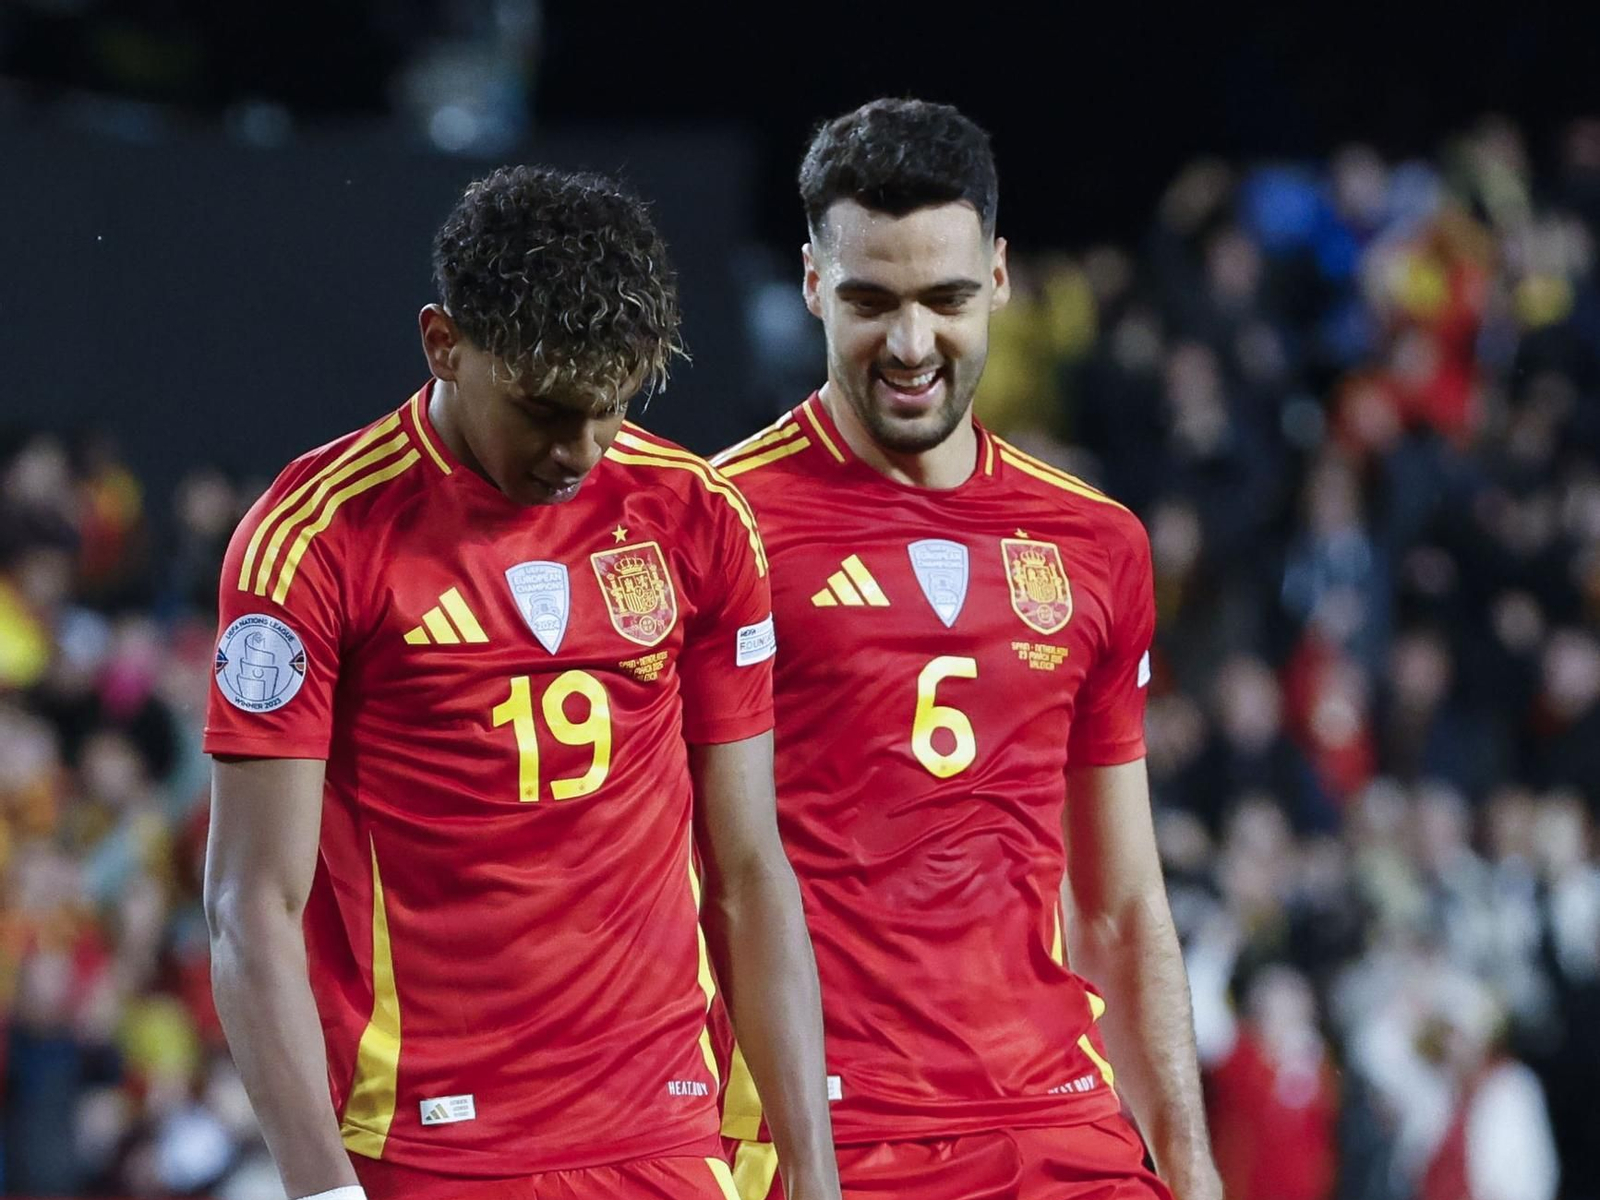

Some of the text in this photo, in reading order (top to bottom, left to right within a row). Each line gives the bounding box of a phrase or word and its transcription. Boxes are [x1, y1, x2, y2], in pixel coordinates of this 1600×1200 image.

[513, 572, 562, 584] EUROPEAN
[239, 617, 268, 627] NATIONS
[270, 620, 295, 642] LEAGUE
[234, 696, 263, 710] WINNER
[911, 655, 978, 778] 6
[493, 670, 612, 802] 19
